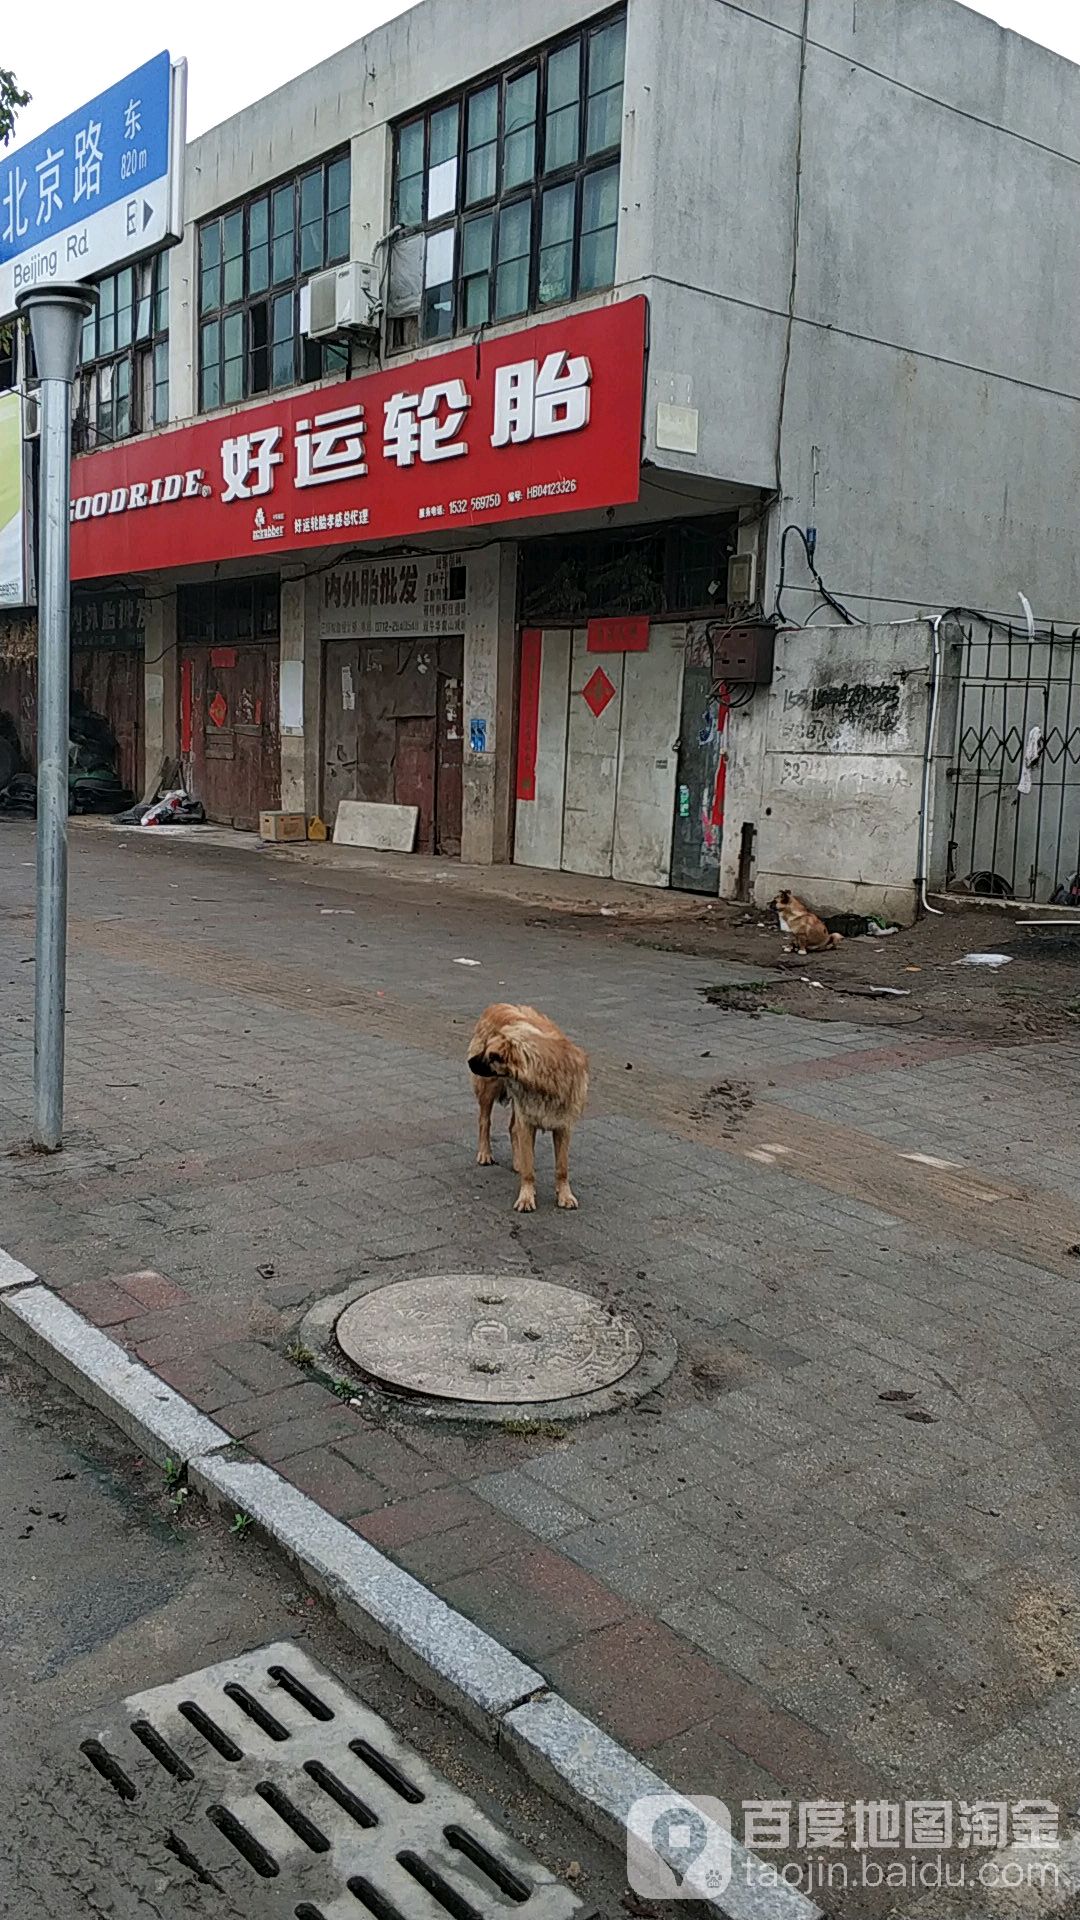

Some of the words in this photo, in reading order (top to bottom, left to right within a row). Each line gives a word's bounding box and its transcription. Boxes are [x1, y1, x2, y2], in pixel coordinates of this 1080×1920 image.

[124, 98, 142, 141] 东
[2, 119, 103, 243] 北京路
[126, 199, 137, 236] E
[13, 250, 58, 289] Beijing
[66, 228, 89, 262] Rd
[220, 349, 592, 503] 好运轮胎
[293, 508, 369, 534] 好运轮胎孝感总代理
[449, 499, 468, 515] 1532
[324, 564, 418, 608] 内外胎批发
